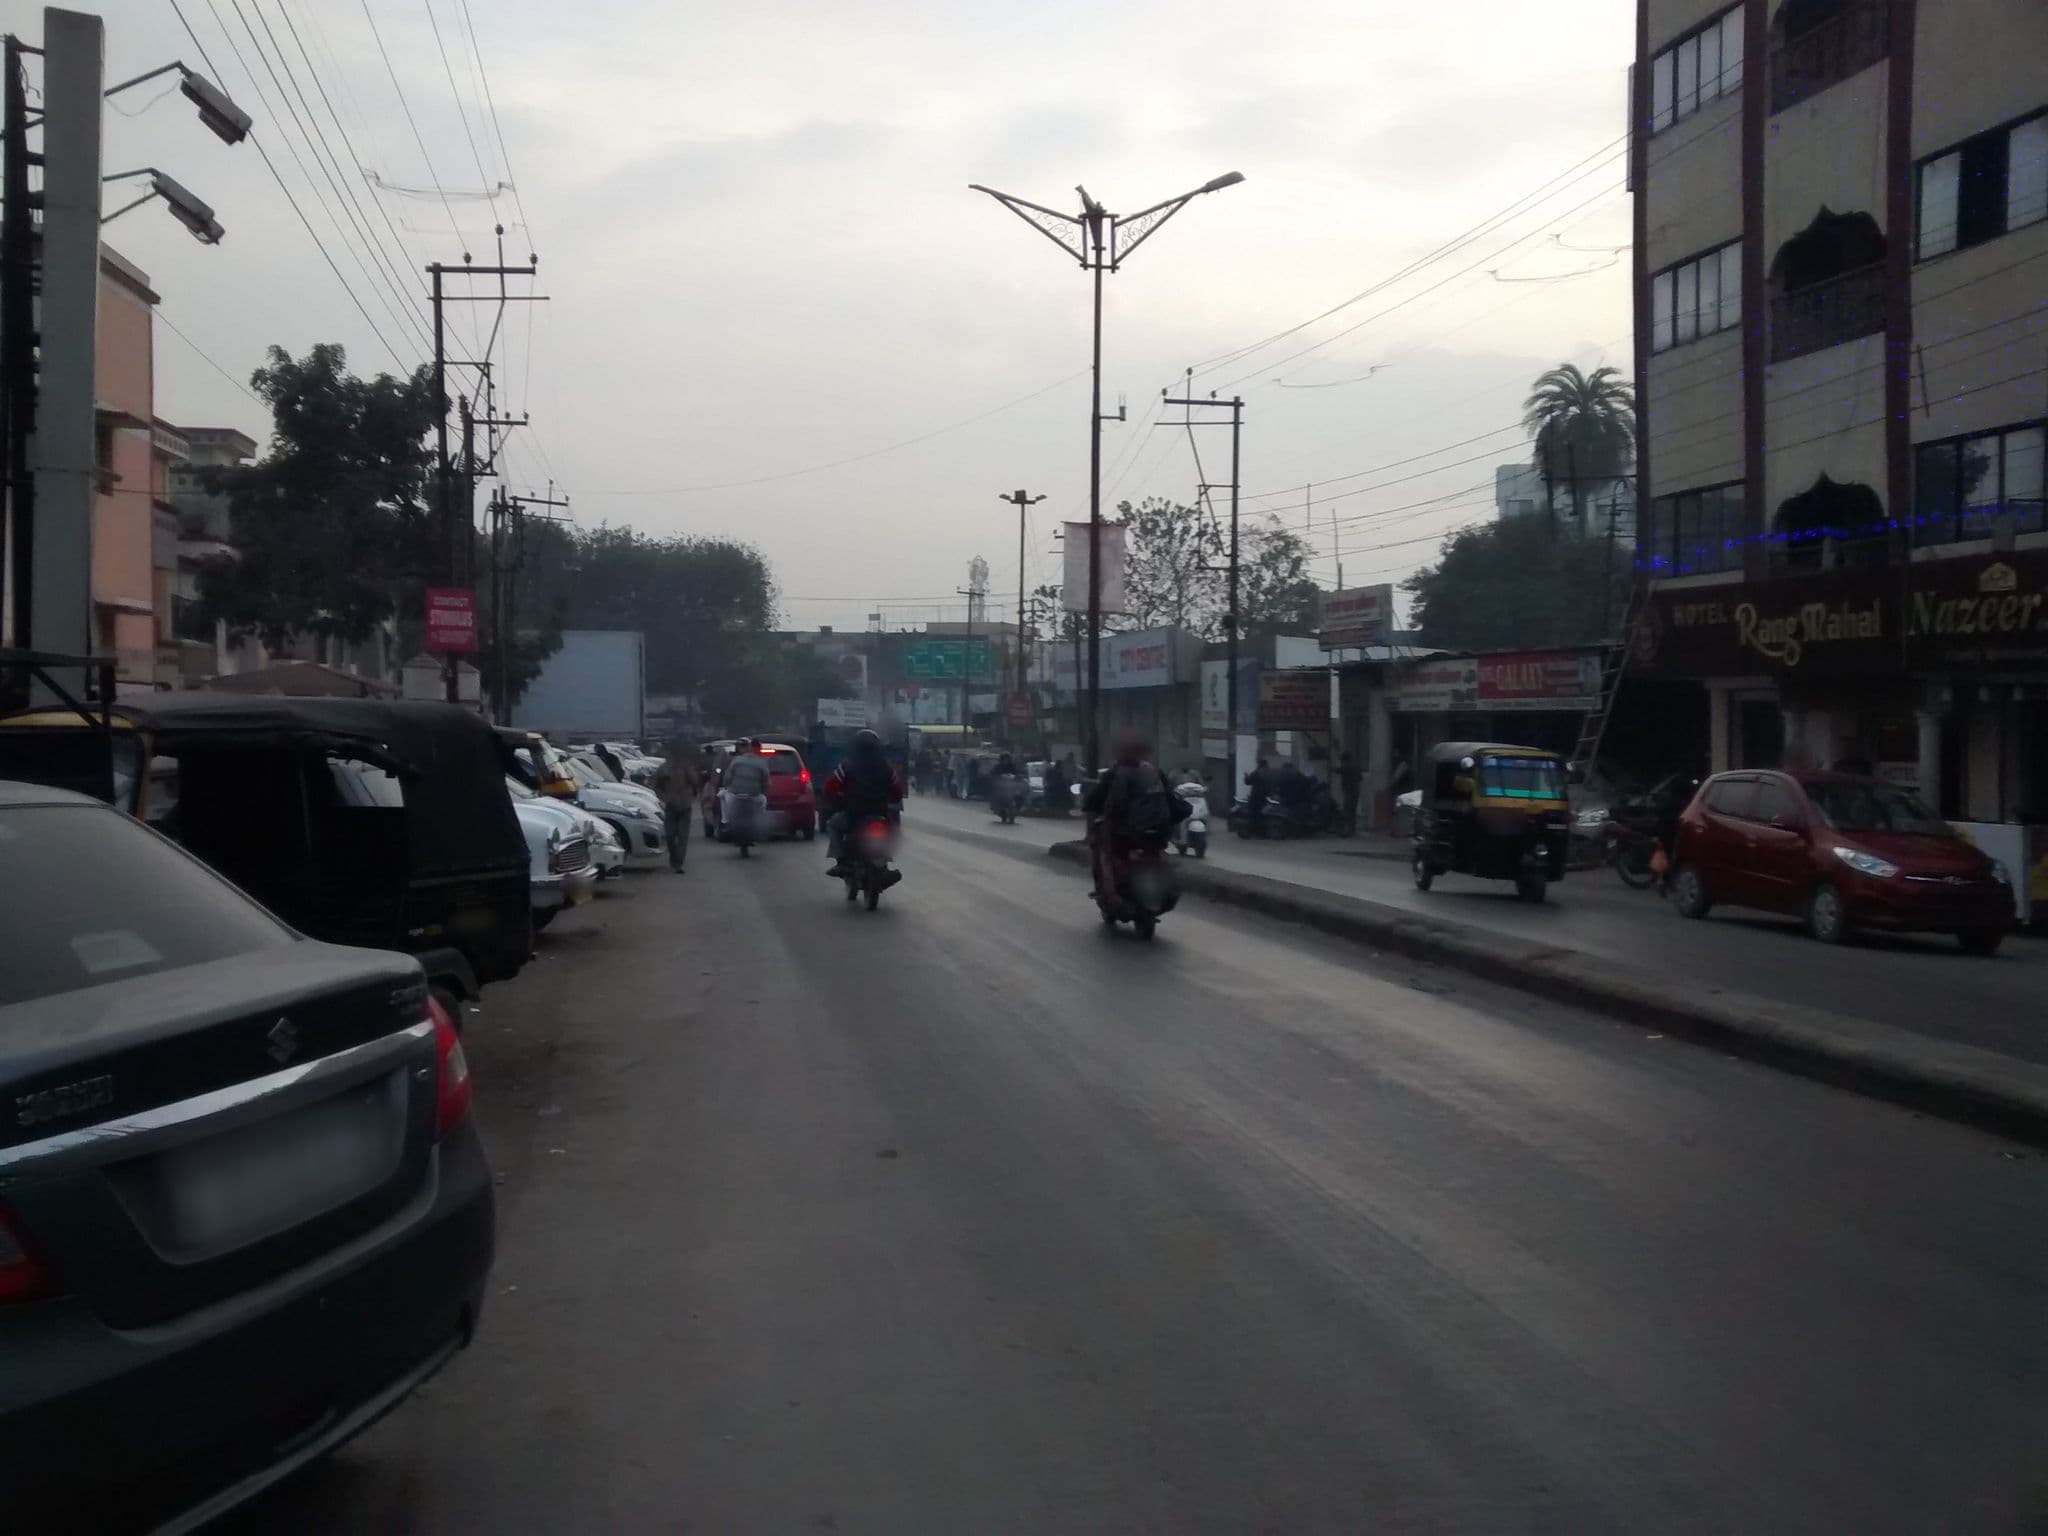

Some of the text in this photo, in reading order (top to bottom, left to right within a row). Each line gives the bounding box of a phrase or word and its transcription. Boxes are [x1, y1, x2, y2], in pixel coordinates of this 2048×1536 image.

[1673, 596, 1882, 666] HOTEL Rang Mahal
[1907, 592, 2041, 634] Nazeer
